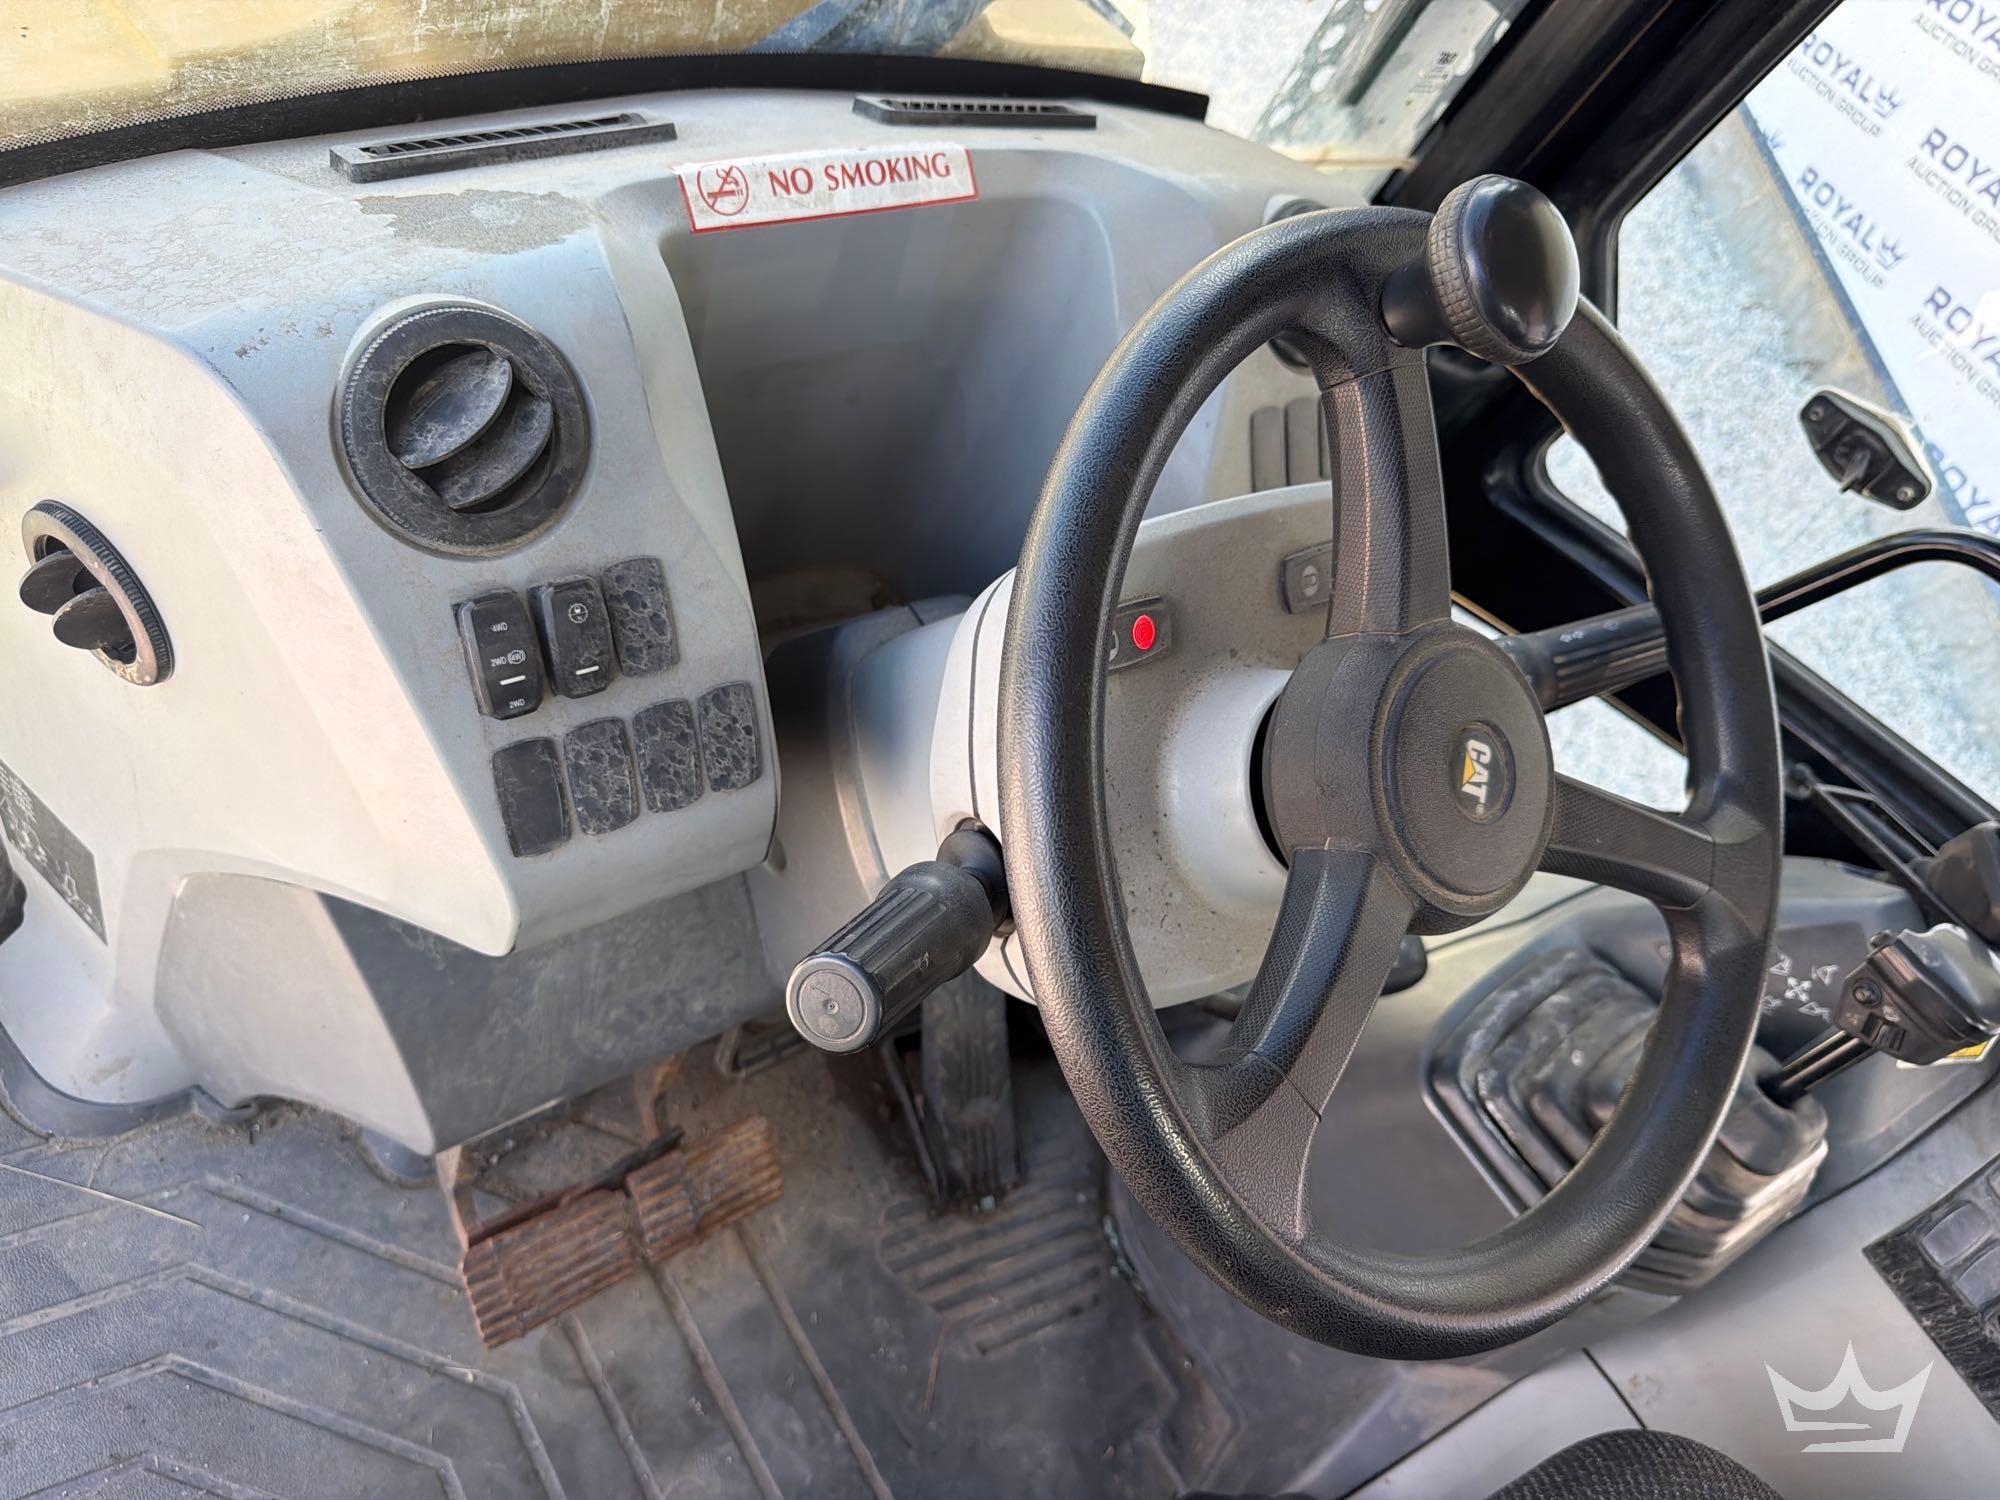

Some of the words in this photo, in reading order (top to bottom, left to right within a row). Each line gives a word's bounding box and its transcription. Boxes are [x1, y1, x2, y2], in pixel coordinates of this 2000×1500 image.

[768, 167, 813, 197] NO
[824, 152, 950, 192] SMOKING
[1905, 155, 1975, 217] AUCTION
[492, 622, 508, 632] 4WD
[491, 656, 507, 667] 2WD
[508, 698, 525, 709] 2WD
